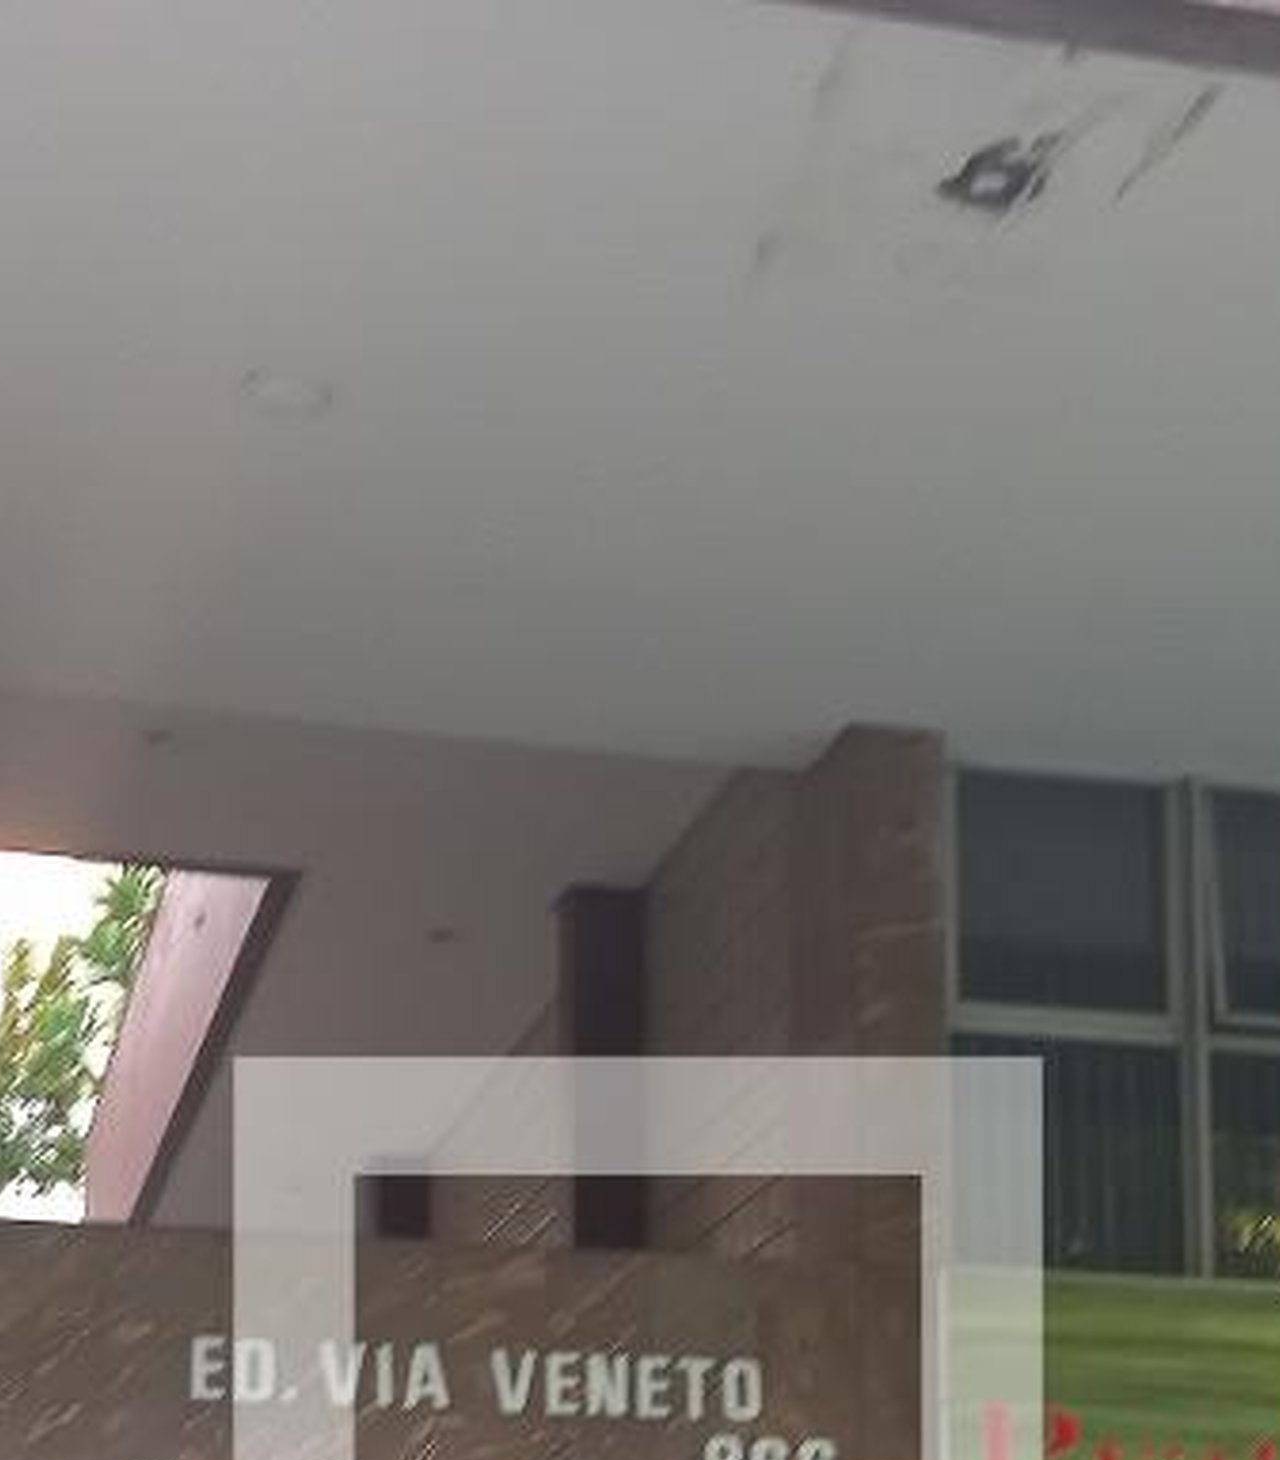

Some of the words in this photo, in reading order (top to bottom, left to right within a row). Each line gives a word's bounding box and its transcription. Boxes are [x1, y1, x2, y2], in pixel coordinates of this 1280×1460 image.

[189, 1336, 300, 1401] ED.
[321, 1339, 452, 1409] VIA
[490, 1347, 765, 1421] VENETO
